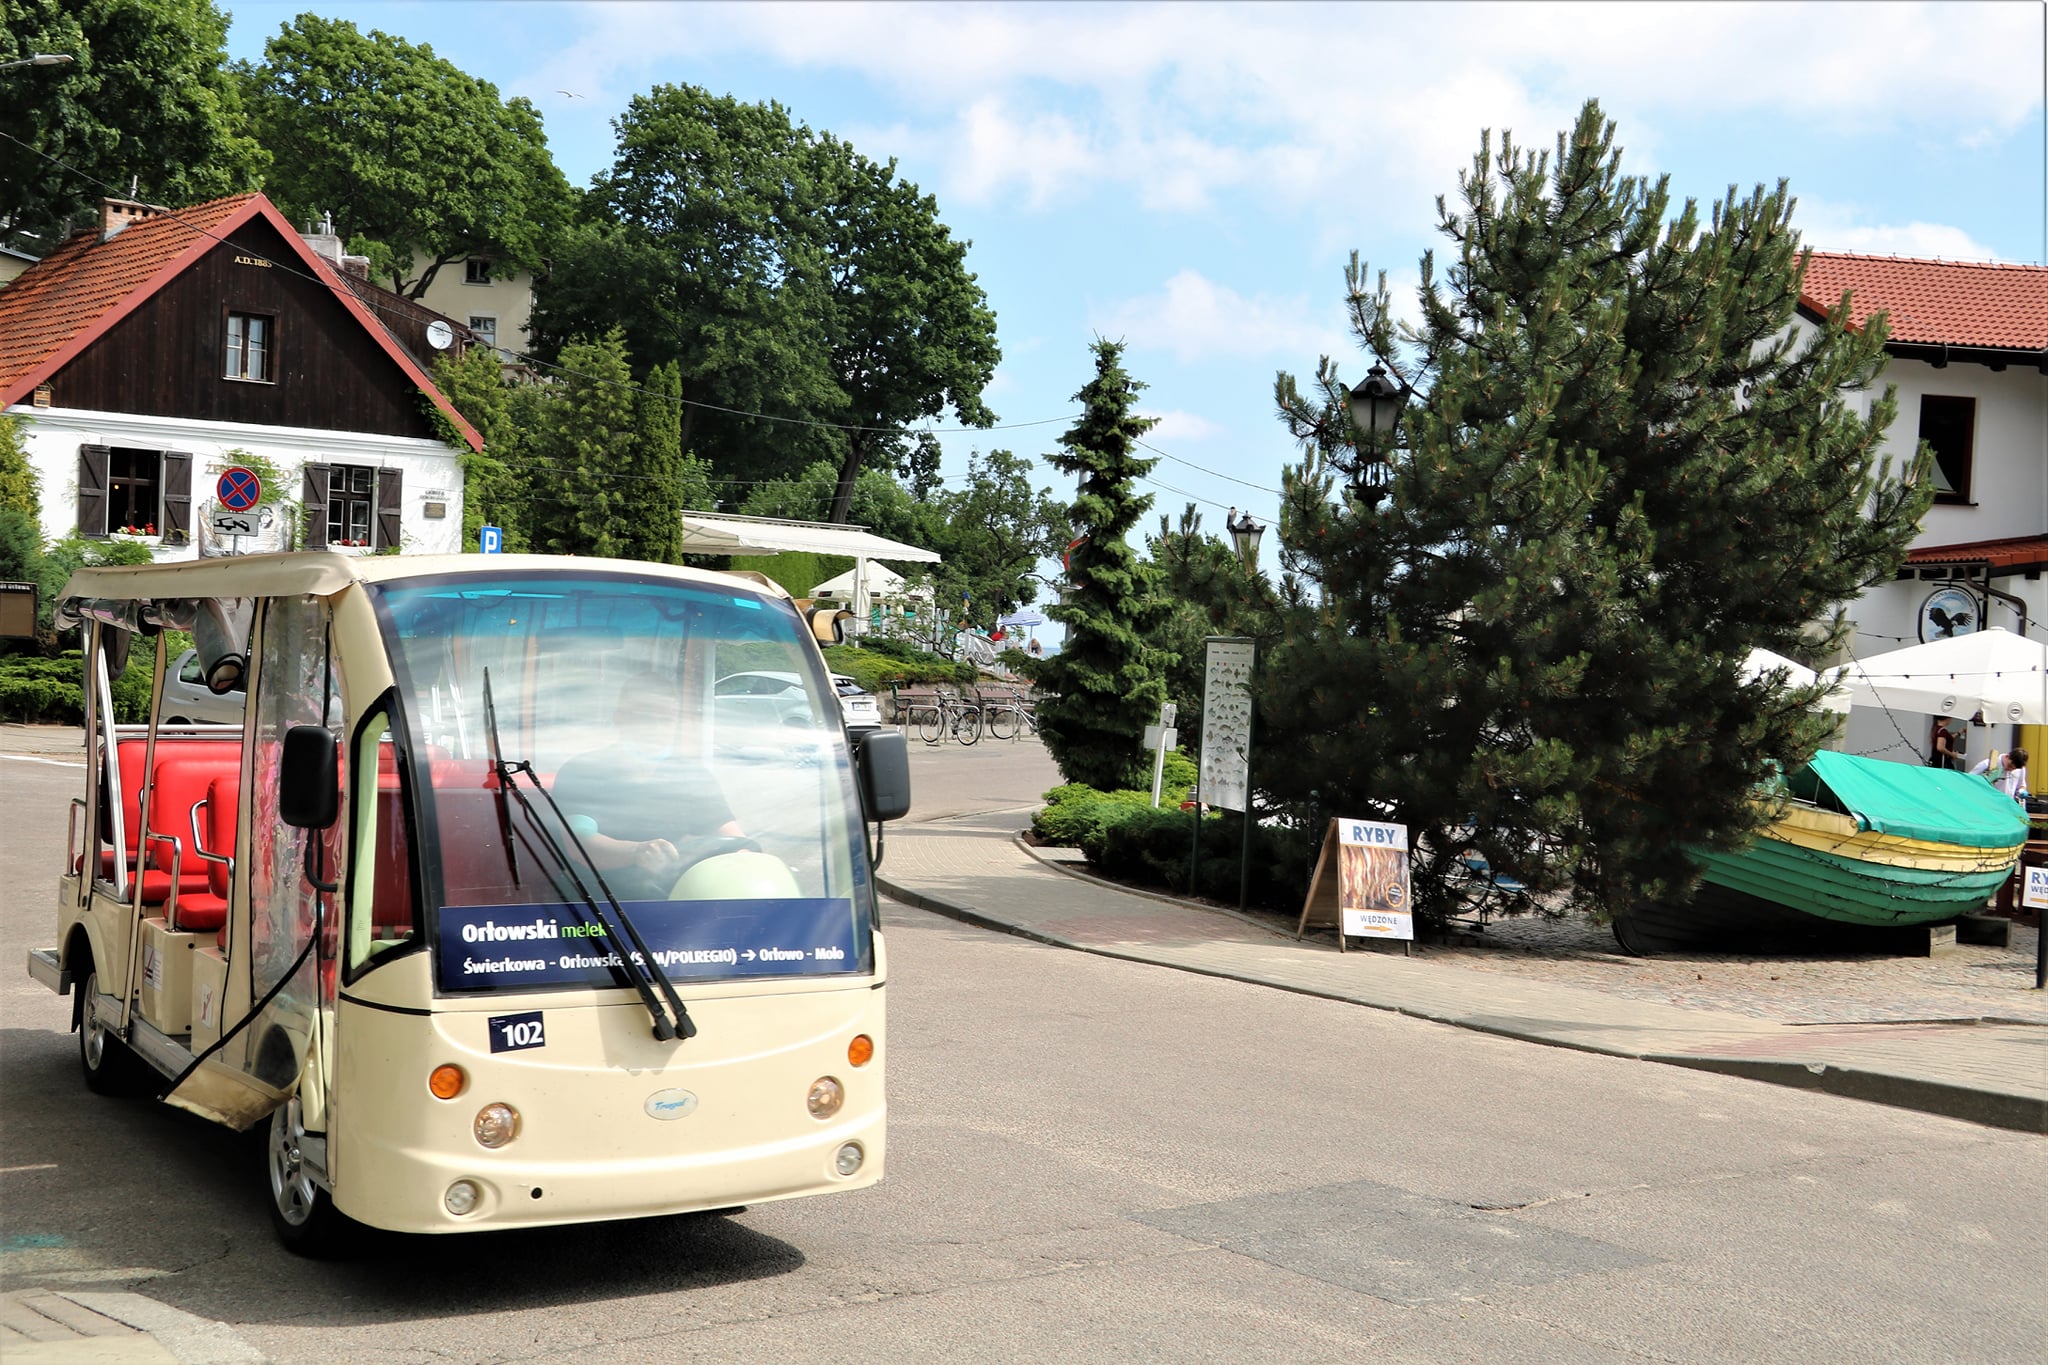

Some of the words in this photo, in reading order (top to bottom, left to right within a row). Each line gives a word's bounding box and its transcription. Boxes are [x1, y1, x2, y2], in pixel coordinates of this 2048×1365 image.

[485, 531, 497, 553] P
[1353, 826, 1395, 844] RYBY
[462, 919, 558, 942] Orłowski
[561, 921, 615, 938] melek
[1360, 915, 1398, 925] WĘDZONE
[463, 957, 546, 974] Świerkowa
[629, 948, 738, 968] (SM/POLREGIO)
[759, 947, 804, 962] Orłowo
[815, 946, 845, 961] Molo
[501, 1021, 544, 1047] 102
